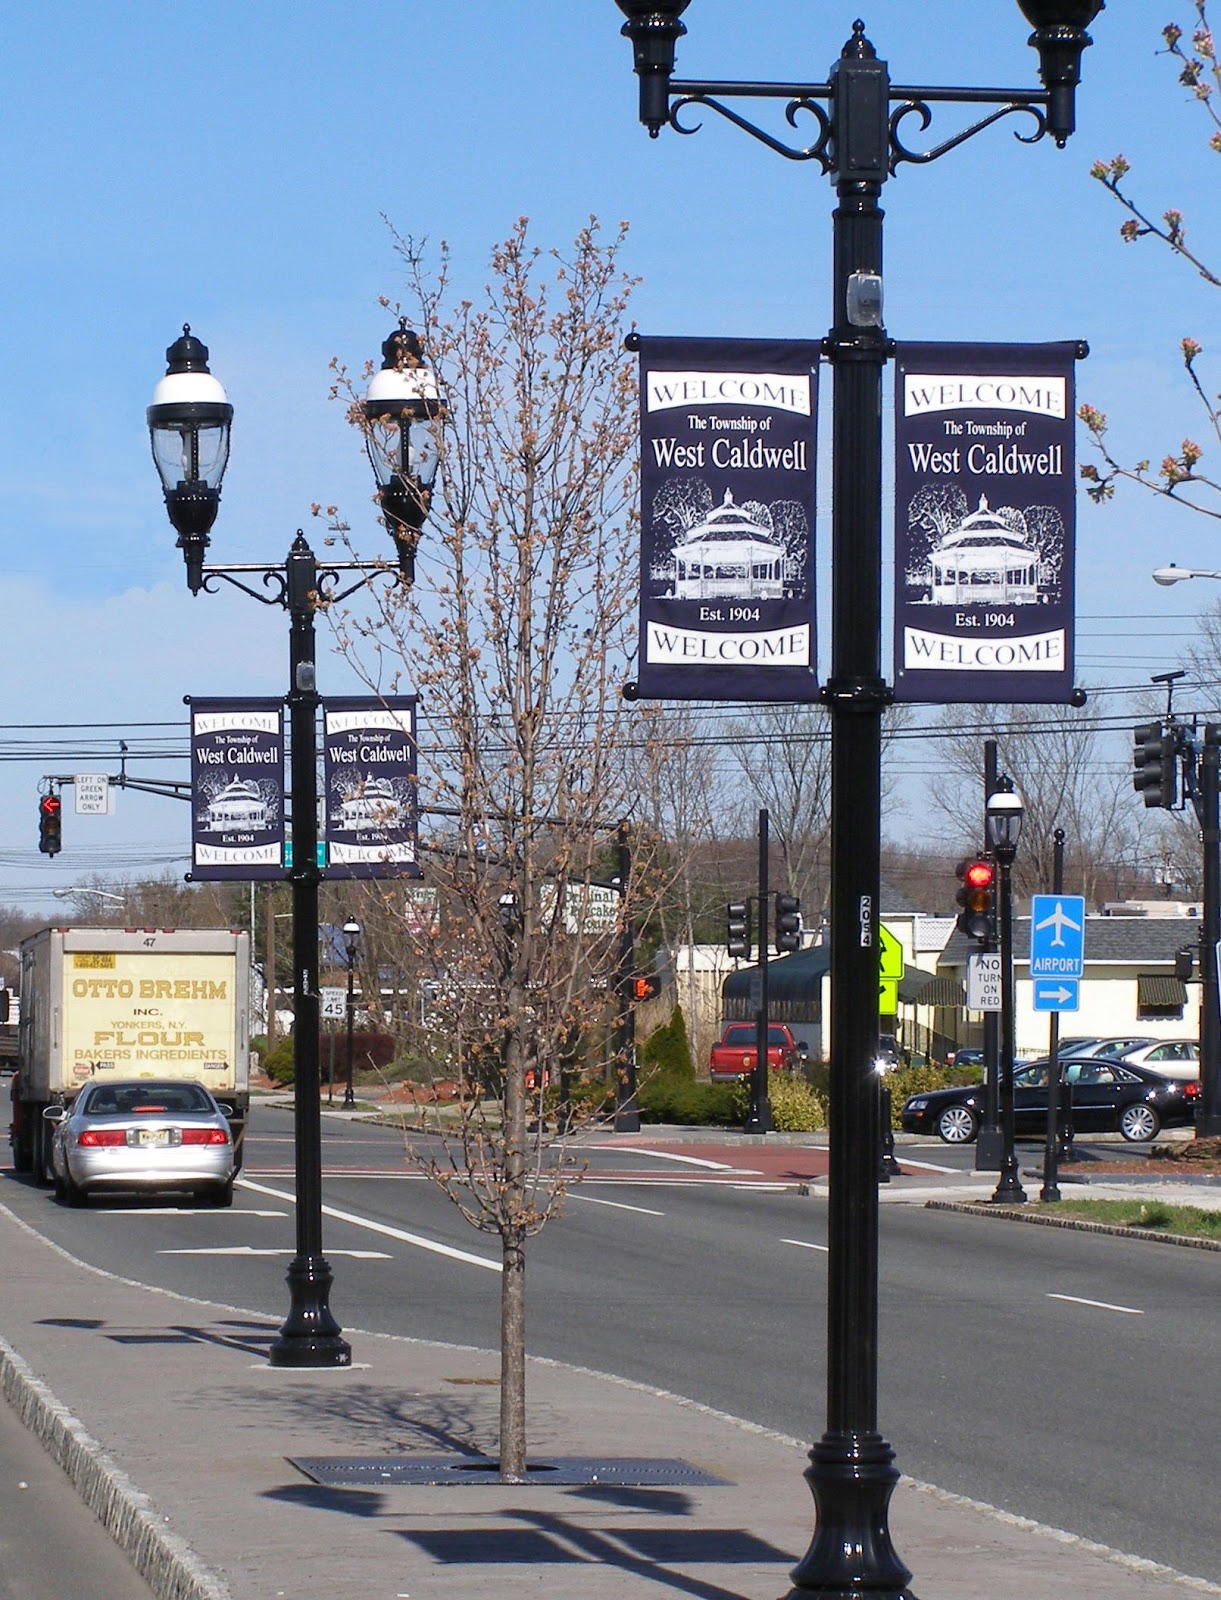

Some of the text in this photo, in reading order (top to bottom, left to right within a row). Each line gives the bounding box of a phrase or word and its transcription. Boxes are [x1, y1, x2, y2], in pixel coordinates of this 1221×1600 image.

[653, 379, 806, 410] WELCOME
[910, 383, 1061, 412] WELCOME
[687, 415, 772, 433] The Township of
[943, 420, 1027, 439] The Township of
[651, 437, 807, 471] West Caldwell
[907, 443, 1063, 475] West Caldwell
[699, 606, 760, 621] Est. 1904
[954, 612, 1015, 627] Est. 1904
[653, 631, 805, 660] WELCOME
[910, 637, 1061, 666] WELCOME
[197, 716, 274, 731] WELCOME
[214, 734, 259, 745] The Township of
[347, 733, 391, 744] The Township of
[196, 746, 278, 764] West Caldwell
[329, 745, 411, 763] West Caldwell
[222, 834, 254, 843] Est. 1904
[356, 833, 371, 841] Est.
[198, 846, 276, 862] WELCOME
[332, 845, 411, 861] WELCME
[565, 889, 614, 902] Oriinal
[571, 903, 616, 917] Pcake
[862, 896, 871, 946] 2054
[143, 938, 156, 947] 47
[981, 959, 1000, 970] NO
[1034, 957, 1080, 972] AIRPORT
[978, 973, 1003, 982] TURN
[72, 979, 226, 1000] OTTO BREHM
[983, 985, 997, 994] ON
[980, 996, 1000, 1005] RED
[133, 1008, 163, 1016] INC.
[324, 1003, 343, 1015] 45
[111, 1021, 187, 1031] YONKERS, N.Y.
[94, 1031, 205, 1047] FLOUR
[74, 1049, 228, 1060] BAKERS INGREDIENTS
